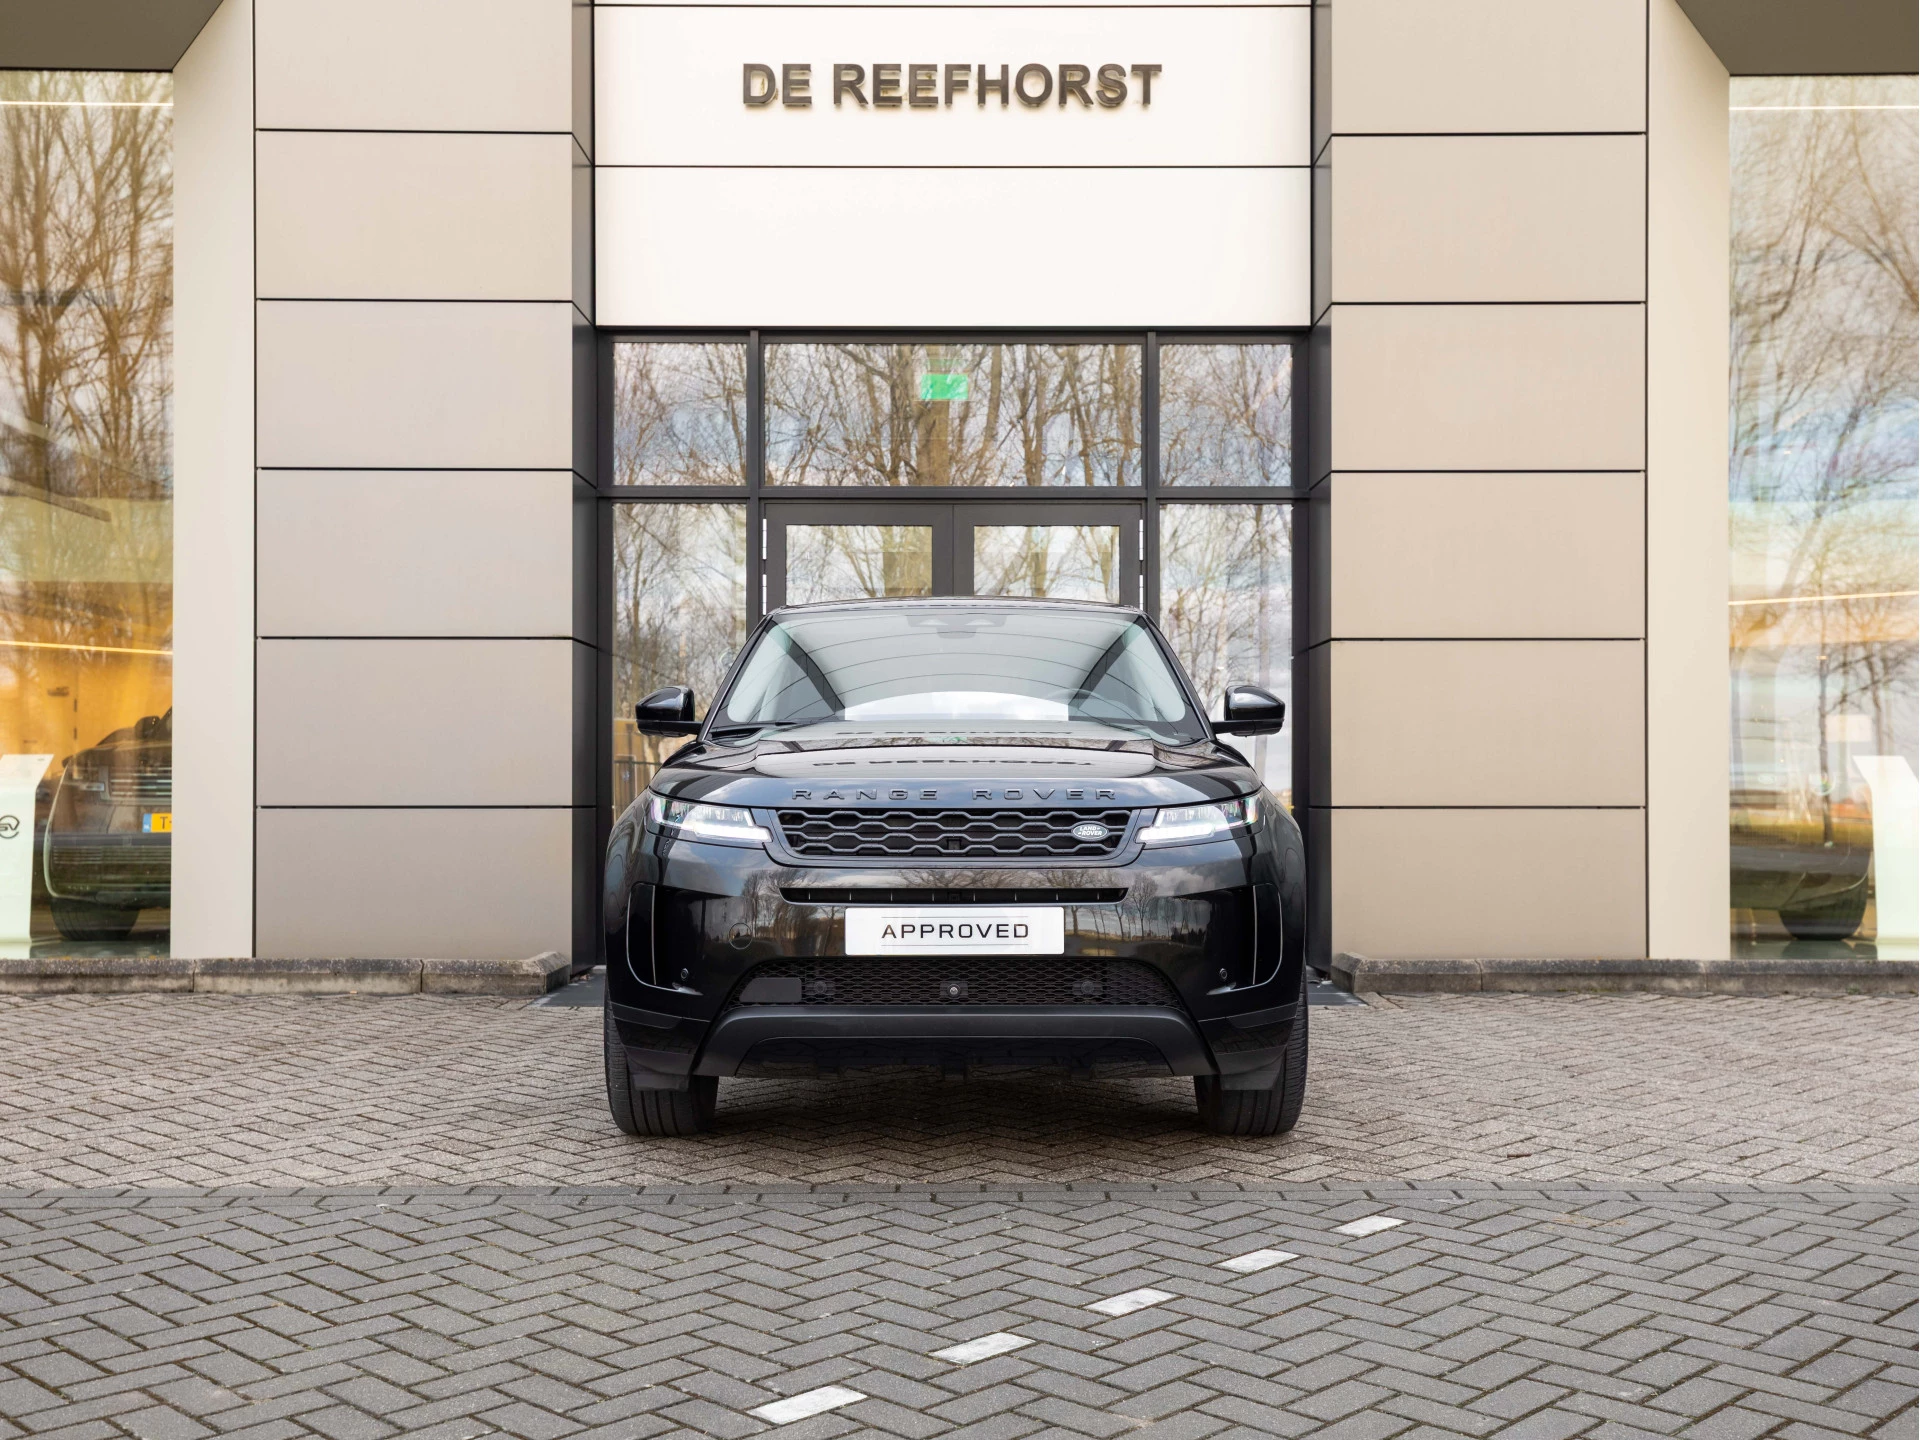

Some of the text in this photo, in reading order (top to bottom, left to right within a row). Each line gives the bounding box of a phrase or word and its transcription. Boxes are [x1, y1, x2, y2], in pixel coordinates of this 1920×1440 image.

[743, 63, 1163, 107] DE REEFHORST
[792, 788, 1116, 800] RANGE ROVER
[881, 924, 1029, 939] APPROVED
